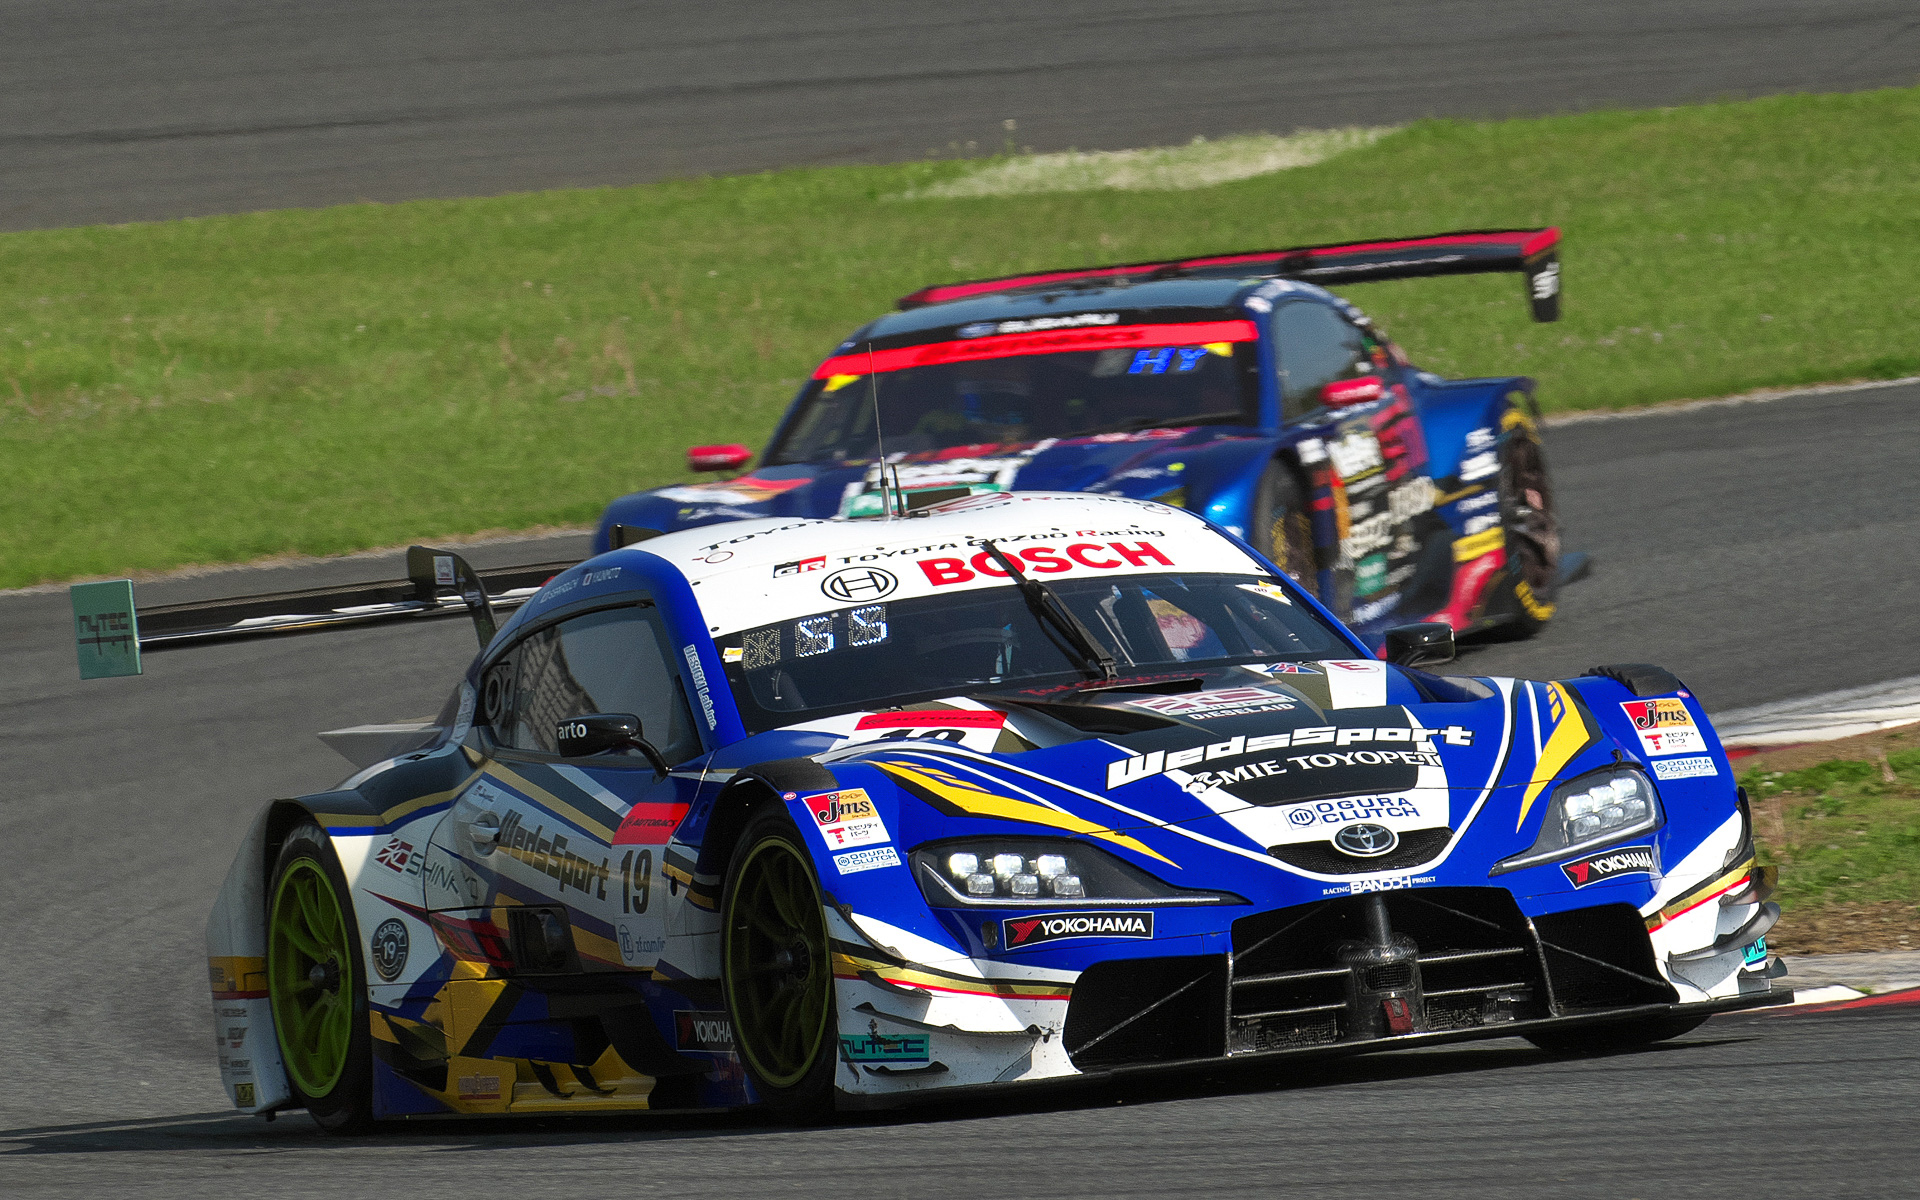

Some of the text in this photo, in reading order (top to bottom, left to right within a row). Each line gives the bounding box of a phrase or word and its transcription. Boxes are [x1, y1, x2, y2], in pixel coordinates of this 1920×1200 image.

[837, 542, 958, 564] TOYOTA
[1075, 527, 1166, 538] Racing
[917, 541, 1175, 586] BOSCH
[558, 722, 588, 740] arto
[1106, 726, 1476, 791] WedsSport
[1217, 751, 1443, 785] MIE TOYOPET
[1316, 797, 1414, 812] OGURA
[1322, 807, 1421, 824] CLUTCH
[500, 809, 610, 902] WedsSport
[850, 848, 894, 860] OGURA
[852, 854, 898, 866] CLUTCH
[1589, 851, 1655, 876] YOKOHAMA
[620, 849, 653, 915] 19
[1323, 885, 1350, 896] RACING
[1412, 876, 1436, 885] PROJECT
[1040, 917, 1147, 937] YOKOHAMA
[383, 941, 397, 960] 19
